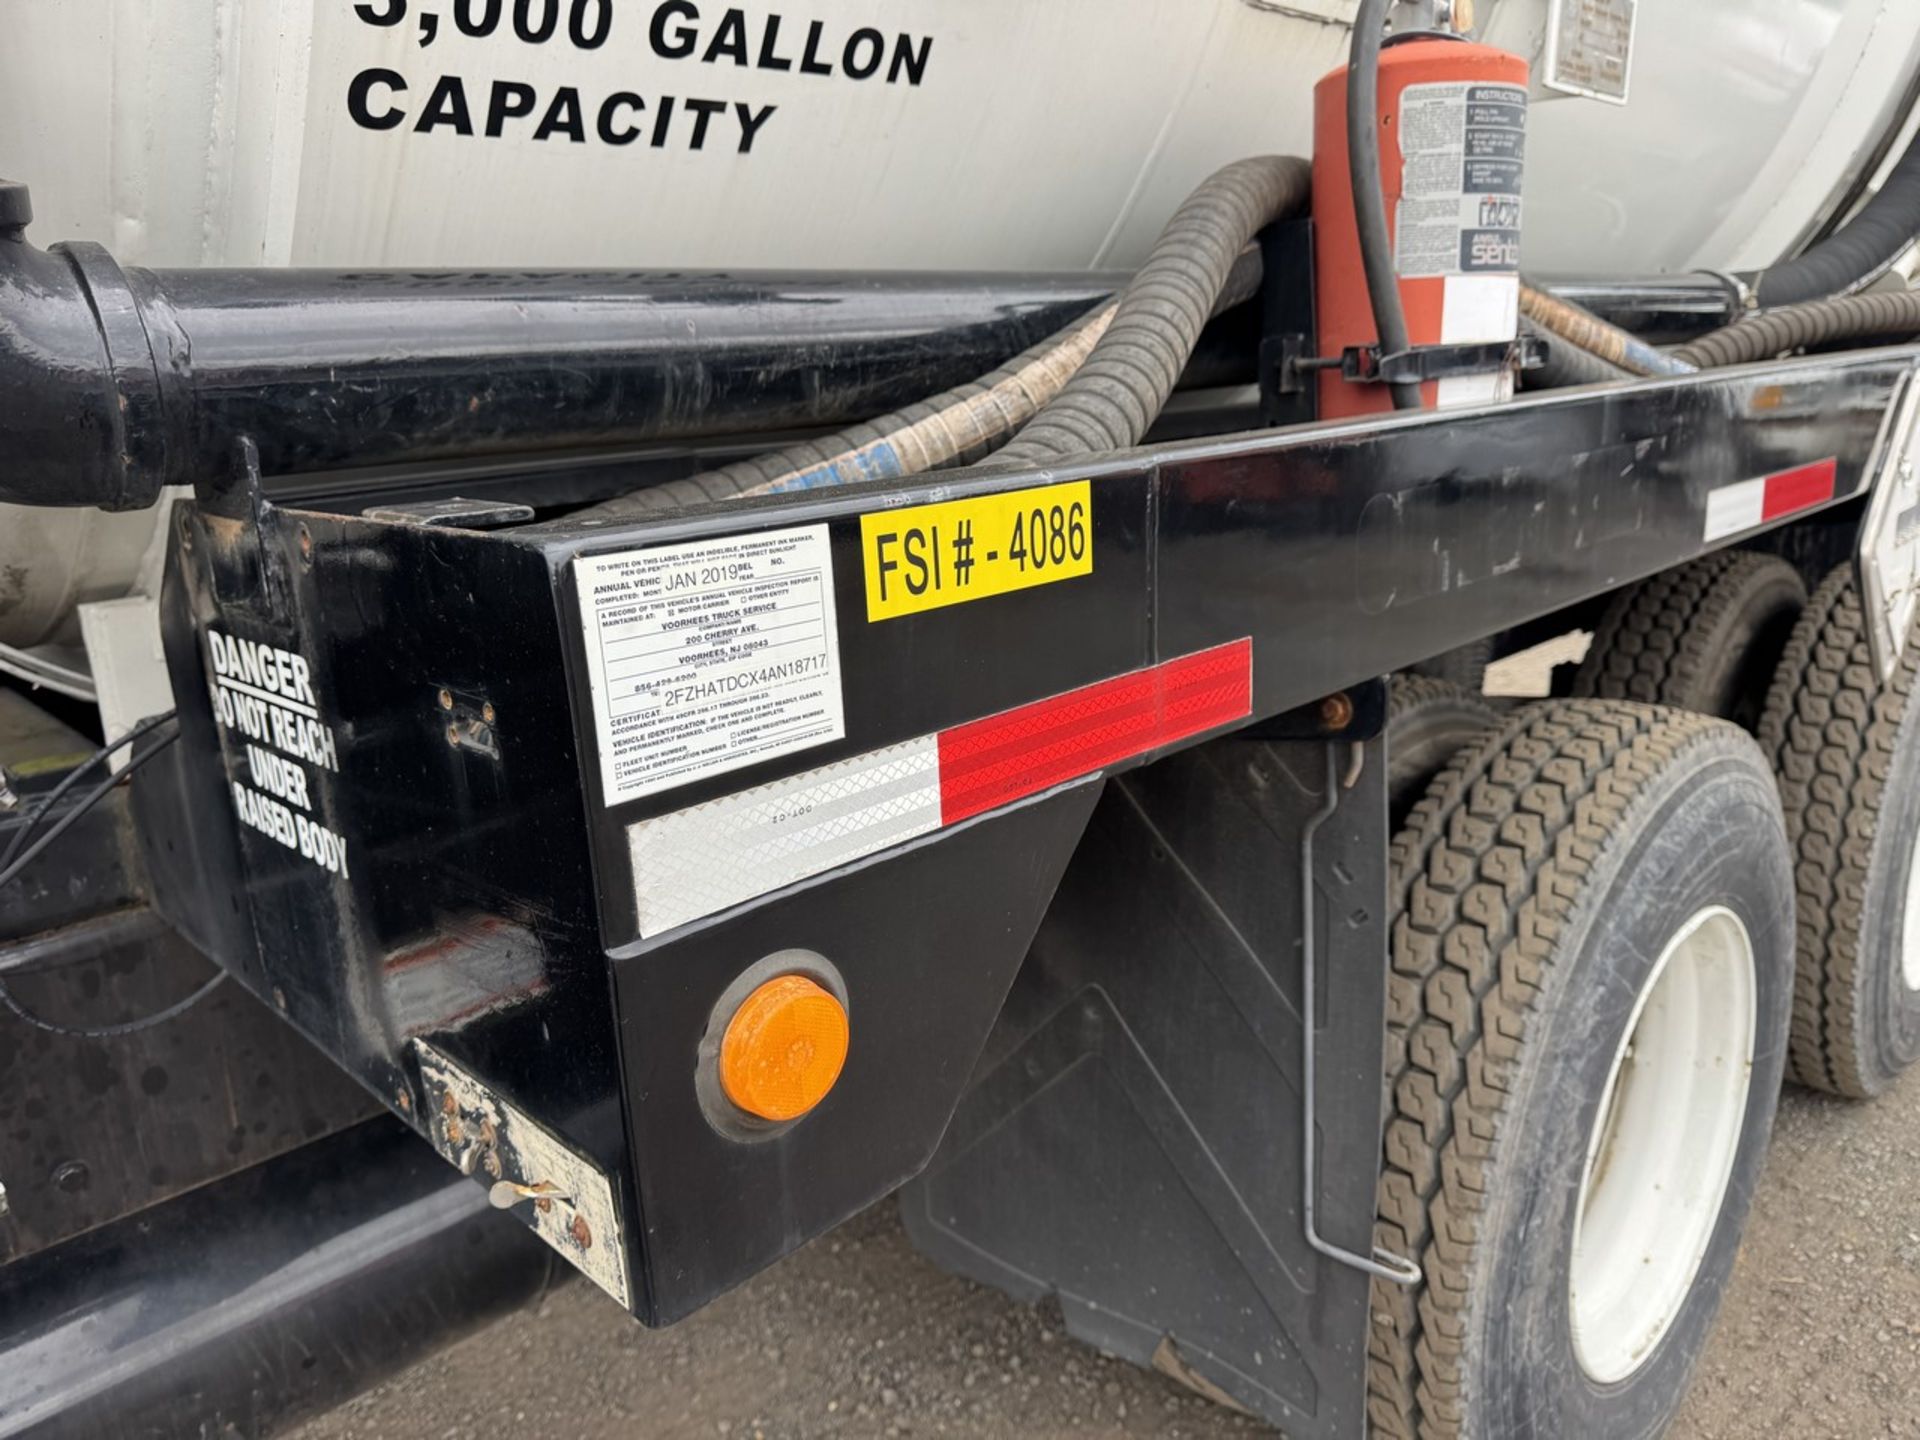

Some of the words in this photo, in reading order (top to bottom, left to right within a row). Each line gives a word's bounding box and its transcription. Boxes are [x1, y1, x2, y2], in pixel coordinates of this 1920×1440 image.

[648, 0, 933, 86] GALLON
[347, 67, 778, 153] CAPACITY
[596, 564, 606, 572] TO
[607, 561, 629, 570] WRITE
[631, 559, 641, 567] ON
[642, 557, 658, 565] THIS
[659, 554, 680, 563] LABEL
[681, 551, 694, 559] USE
[706, 545, 740, 556] INDELIBLE,
[740, 540, 776, 551] PERMANENT
[788, 534, 814, 544] MARKER,
[620, 568, 635, 577] PEN
[635, 566, 646, 574] OR
[746, 548, 767, 557] DIRECT
[877, 528, 941, 602] FSI
[952, 519, 975, 587] #
[987, 550, 998, 561] -
[1009, 501, 1085, 572] 4086
[592, 580, 632, 595] ANNUAL
[633, 576, 661, 588] VEHIC
[737, 561, 753, 571] BEL
[769, 556, 785, 566] NO.
[664, 569, 697, 591] JAN
[700, 563, 738, 585] 2019
[594, 591, 640, 605] COMPLETED:
[642, 588, 662, 597] MONT
[601, 614, 644, 628] MAINTAINED
[645, 612, 656, 620] AT:
[677, 604, 701, 614] MOTOR
[702, 599, 729, 609] CARRIER
[748, 592, 768, 601] OTHER
[768, 588, 789, 597] ENTITY
[608, 607, 637, 618] RECORD
[650, 602, 665, 610] THIS
[666, 596, 700, 607] VEHICLE'S
[701, 591, 726, 601] ANNUAL
[727, 586, 752, 597] VEHICLE
[754, 580, 788, 592] INSPECTION
[789, 576, 812, 585] REPORT
[661, 614, 710, 631] VOORHEES
[711, 608, 741, 621] TRUCK
[742, 601, 777, 615] SERVICE
[685, 634, 702, 645] 200
[703, 626, 739, 641] CHERRY
[740, 622, 759, 633] AVE.
[208, 629, 316, 706] DANGER
[678, 646, 728, 667] VOORHEES,
[729, 644, 741, 653] NJ
[663, 653, 826, 707] 2FZHATDCX4AN18717
[232, 690, 268, 743] NOT
[269, 704, 339, 773] REACH
[609, 708, 661, 728] CERTIFICAT
[610, 719, 656, 736] ACCORDANCE
[657, 714, 674, 724] WITH
[718, 696, 747, 709] THROUGH
[612, 733, 645, 748] VEHICLE
[646, 717, 708, 739] IDENTIFICATION:
[709, 715, 716, 723] IF
[717, 712, 729, 721] THE
[730, 706, 754, 718] VEHICLE
[761, 701, 773, 710] NOT
[802, 708, 824, 719] NUMBER
[613, 747, 627, 757] AND
[628, 735, 674, 752] PERMANENTLY
[675, 727, 704, 741] MARKED,
[705, 722, 726, 732] CHECK
[727, 718, 739, 727] ONE
[740, 714, 753, 723] AND
[737, 734, 757, 745] OTHER
[622, 756, 642, 767] FLEET
[643, 752, 659, 762] UNIT
[659, 744, 687, 757] NUMBER
[623, 763, 650, 777] VEHICLE
[651, 749, 700, 769] IDENTIFICATION
[701, 742, 727, 755] NUMBER
[246, 743, 312, 812] UNDER
[233, 781, 297, 850] RAISED
[294, 813, 349, 880] BODY
